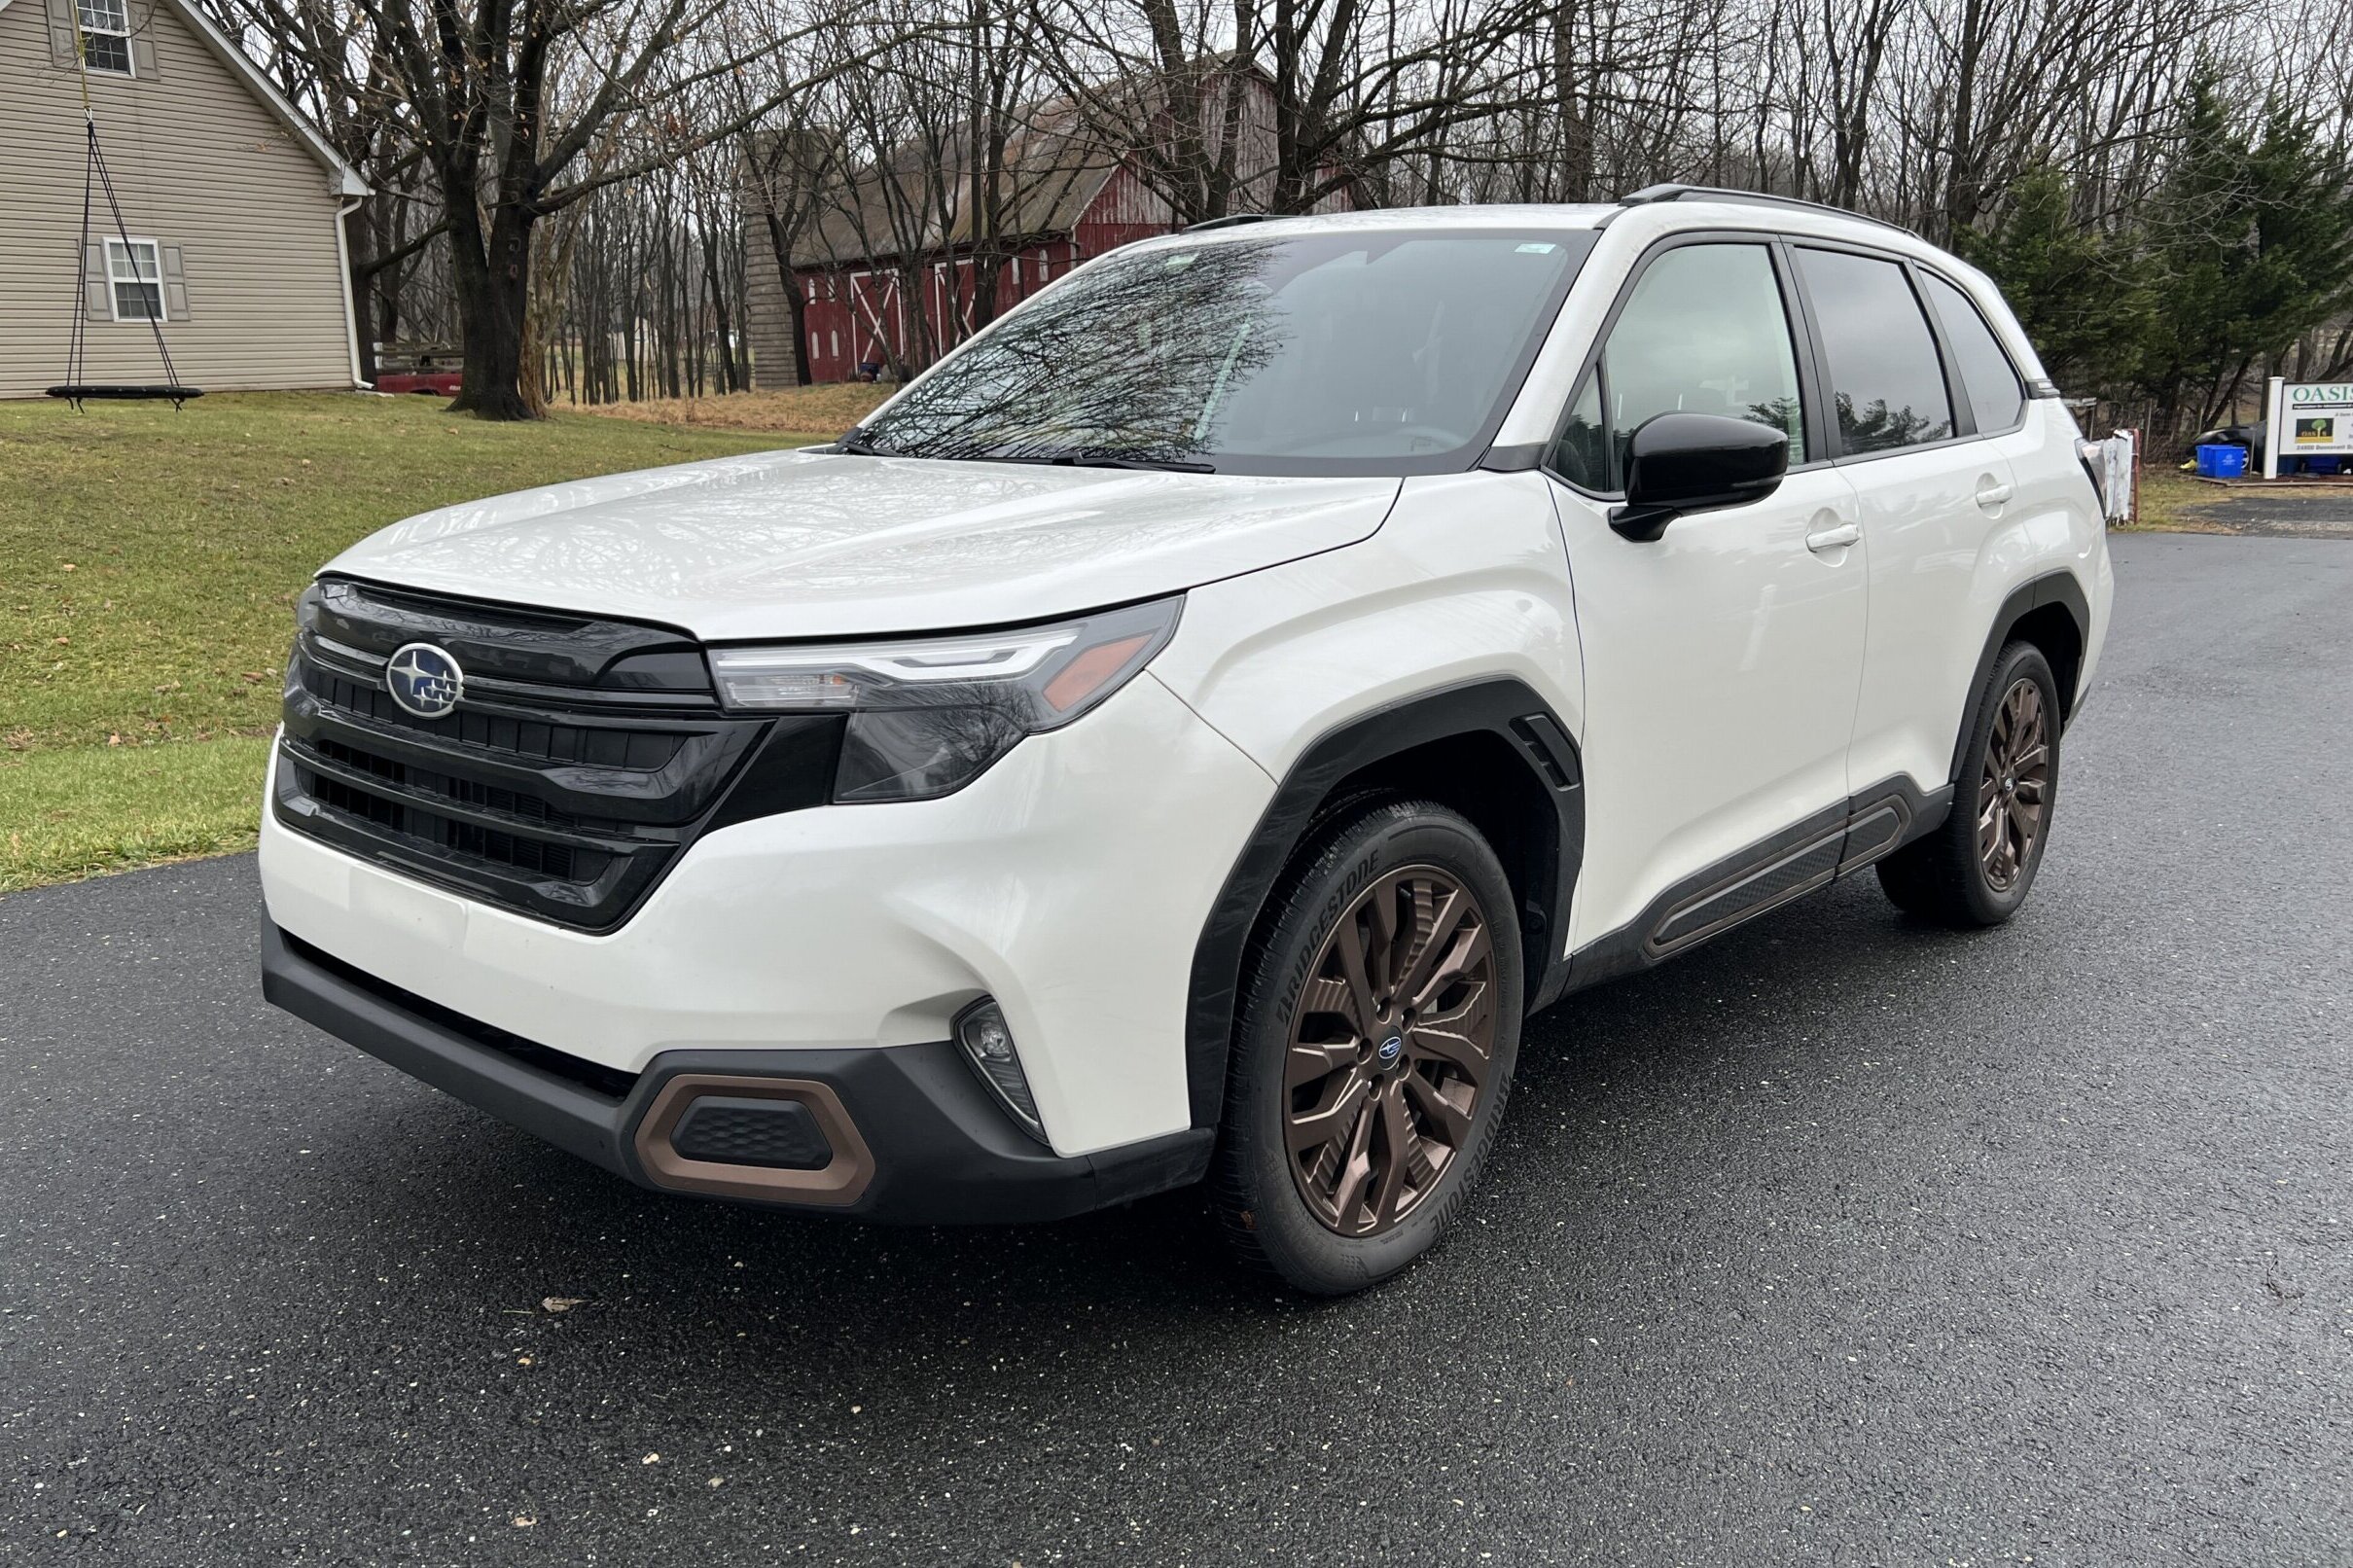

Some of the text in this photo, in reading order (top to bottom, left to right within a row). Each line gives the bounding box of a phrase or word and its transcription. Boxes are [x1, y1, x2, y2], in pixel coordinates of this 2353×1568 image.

[2293, 386, 2353, 402] OASI
[1276, 848, 1379, 1027] BRIDGESTONE
[1430, 1071, 1513, 1236] BRIDGESTONE
